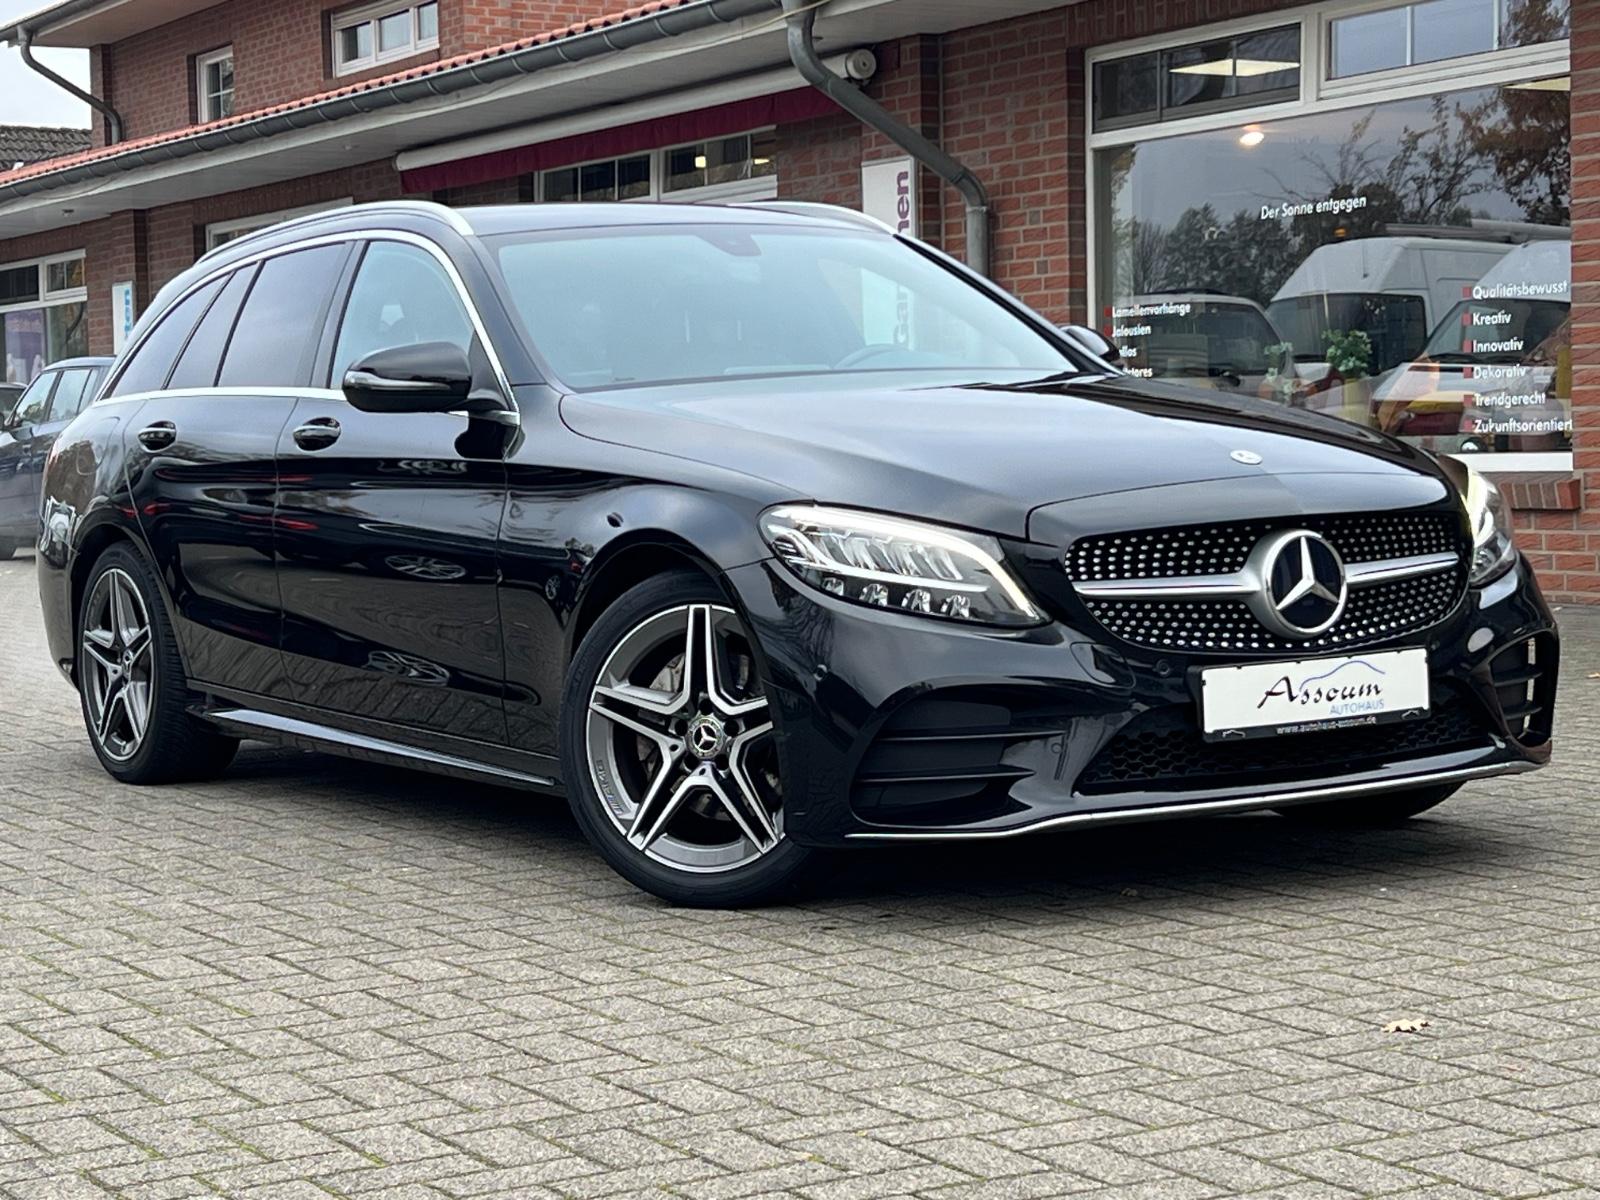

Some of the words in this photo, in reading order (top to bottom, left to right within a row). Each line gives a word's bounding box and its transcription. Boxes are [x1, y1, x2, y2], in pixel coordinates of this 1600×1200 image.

[1261, 205, 1280, 220] Der
[1281, 202, 1313, 217] Sonne
[1316, 196, 1367, 214] entgegen
[1473, 280, 1567, 300] Qualitätsbewusst
[1112, 302, 1191, 318] Lamellenvorhänge
[1473, 310, 1512, 326] Kreativ
[1112, 323, 1152, 338] Jalousien
[1473, 337, 1524, 353] Innovativ
[1474, 364, 1526, 379] Dekorativ
[1474, 391, 1546, 409] Trendgerecht
[1474, 418, 1573, 433] Zukunftsorientiert
[1257, 676, 1382, 708] Assoum
[1329, 699, 1385, 715] AUTOHAUS
